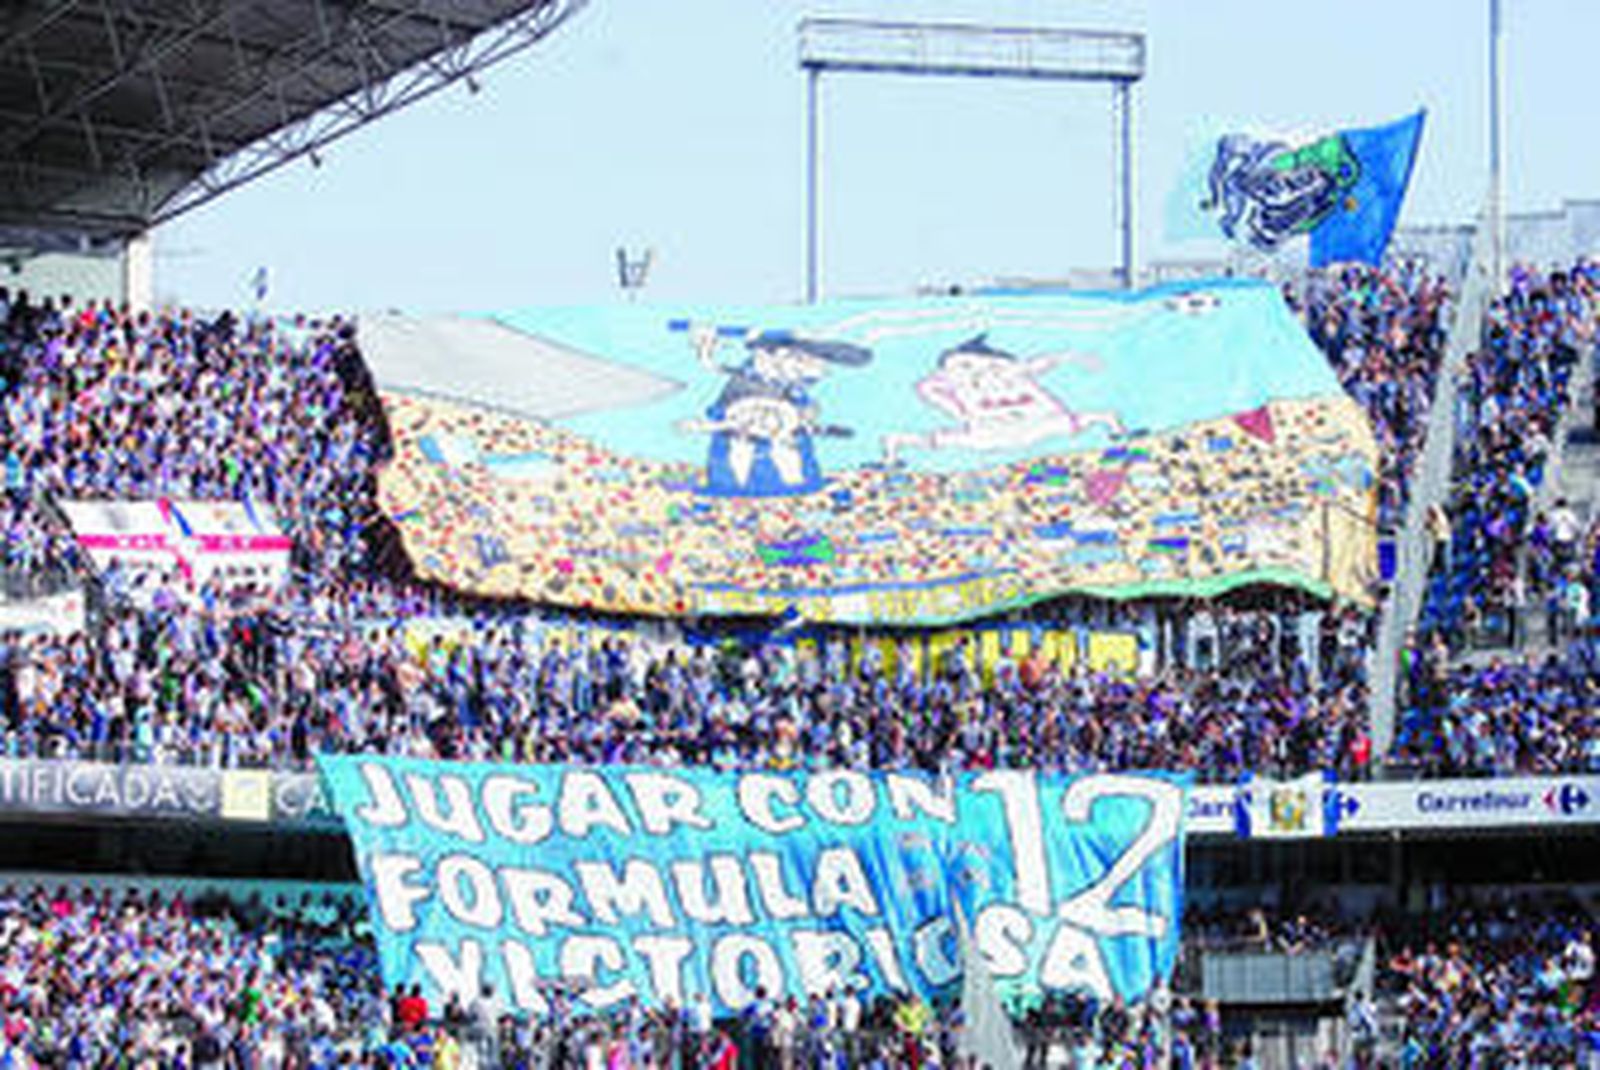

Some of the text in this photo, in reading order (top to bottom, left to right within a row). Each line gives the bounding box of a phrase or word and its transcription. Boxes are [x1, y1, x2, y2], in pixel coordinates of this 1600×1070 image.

[355, 762, 1183, 938] JUGAR CON 12
[1416, 790, 1530, 813] Carrefour
[372, 848, 878, 936] FORMULA
[414, 903, 1113, 1012] VICTORIOSA
